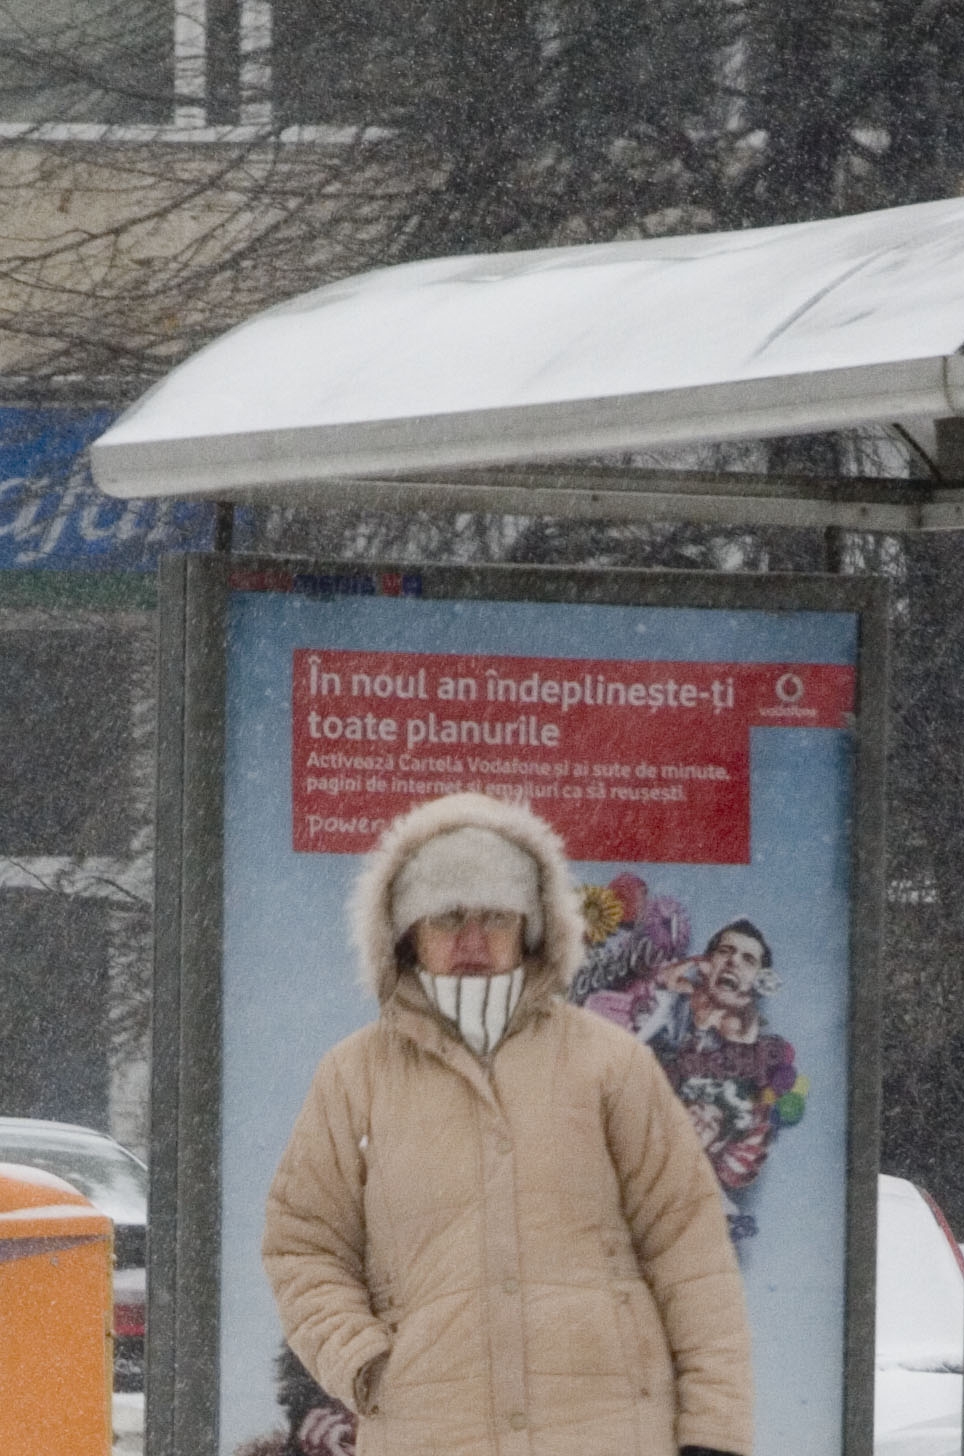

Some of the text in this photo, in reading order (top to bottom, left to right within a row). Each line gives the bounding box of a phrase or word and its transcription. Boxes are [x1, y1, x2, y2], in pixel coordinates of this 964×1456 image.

[307, 654, 735, 715] În noul an îndeplinește-ți
[307, 711, 561, 749] toate planurile
[467, 757, 550, 776] Vodafone
[592, 762, 631, 778] sute
[635, 761, 657, 779] de
[306, 776, 362, 795] pagini
[366, 775, 387, 793] de
[305, 814, 385, 838] power
